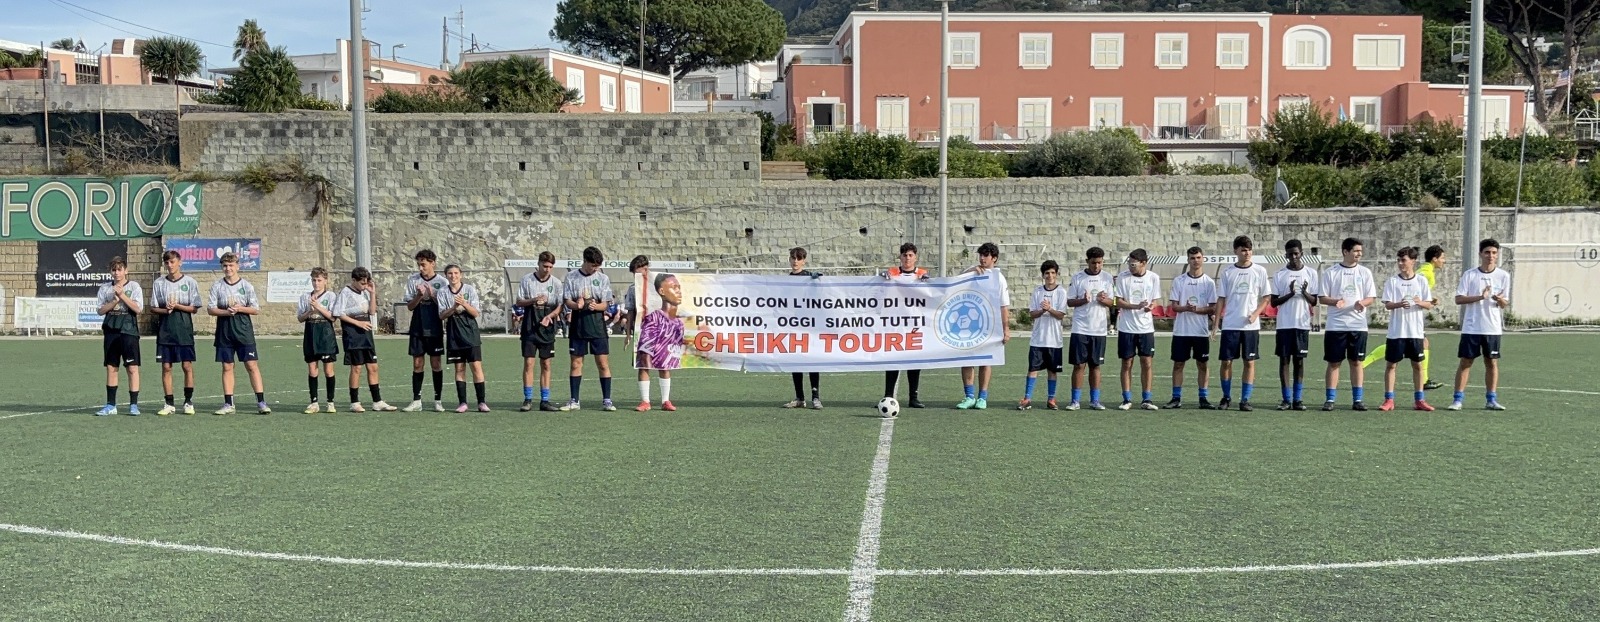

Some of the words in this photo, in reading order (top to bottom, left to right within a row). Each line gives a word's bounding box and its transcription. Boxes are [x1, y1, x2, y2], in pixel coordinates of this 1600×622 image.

[2, 181, 172, 237] FORIO
[169, 248, 214, 260] ORENO
[1580, 248, 1598, 259] 10
[693, 296, 750, 308] UCCISO
[756, 298, 788, 308] CON
[794, 298, 878, 309] L'INGANNO
[884, 298, 898, 308] DI
[905, 298, 926, 307] UN
[962, 293, 982, 304] UNITED
[1554, 294, 1560, 304] 1
[696, 316, 768, 329] PROVINO,
[778, 316, 815, 327] OGGI
[826, 317, 874, 328] SIAMO
[880, 316, 926, 327] TUTTI
[694, 332, 809, 353] CHEIKH
[819, 328, 923, 353] TOURÉ
[942, 335, 964, 347] SCUOLA
[975, 332, 988, 344] VITA
